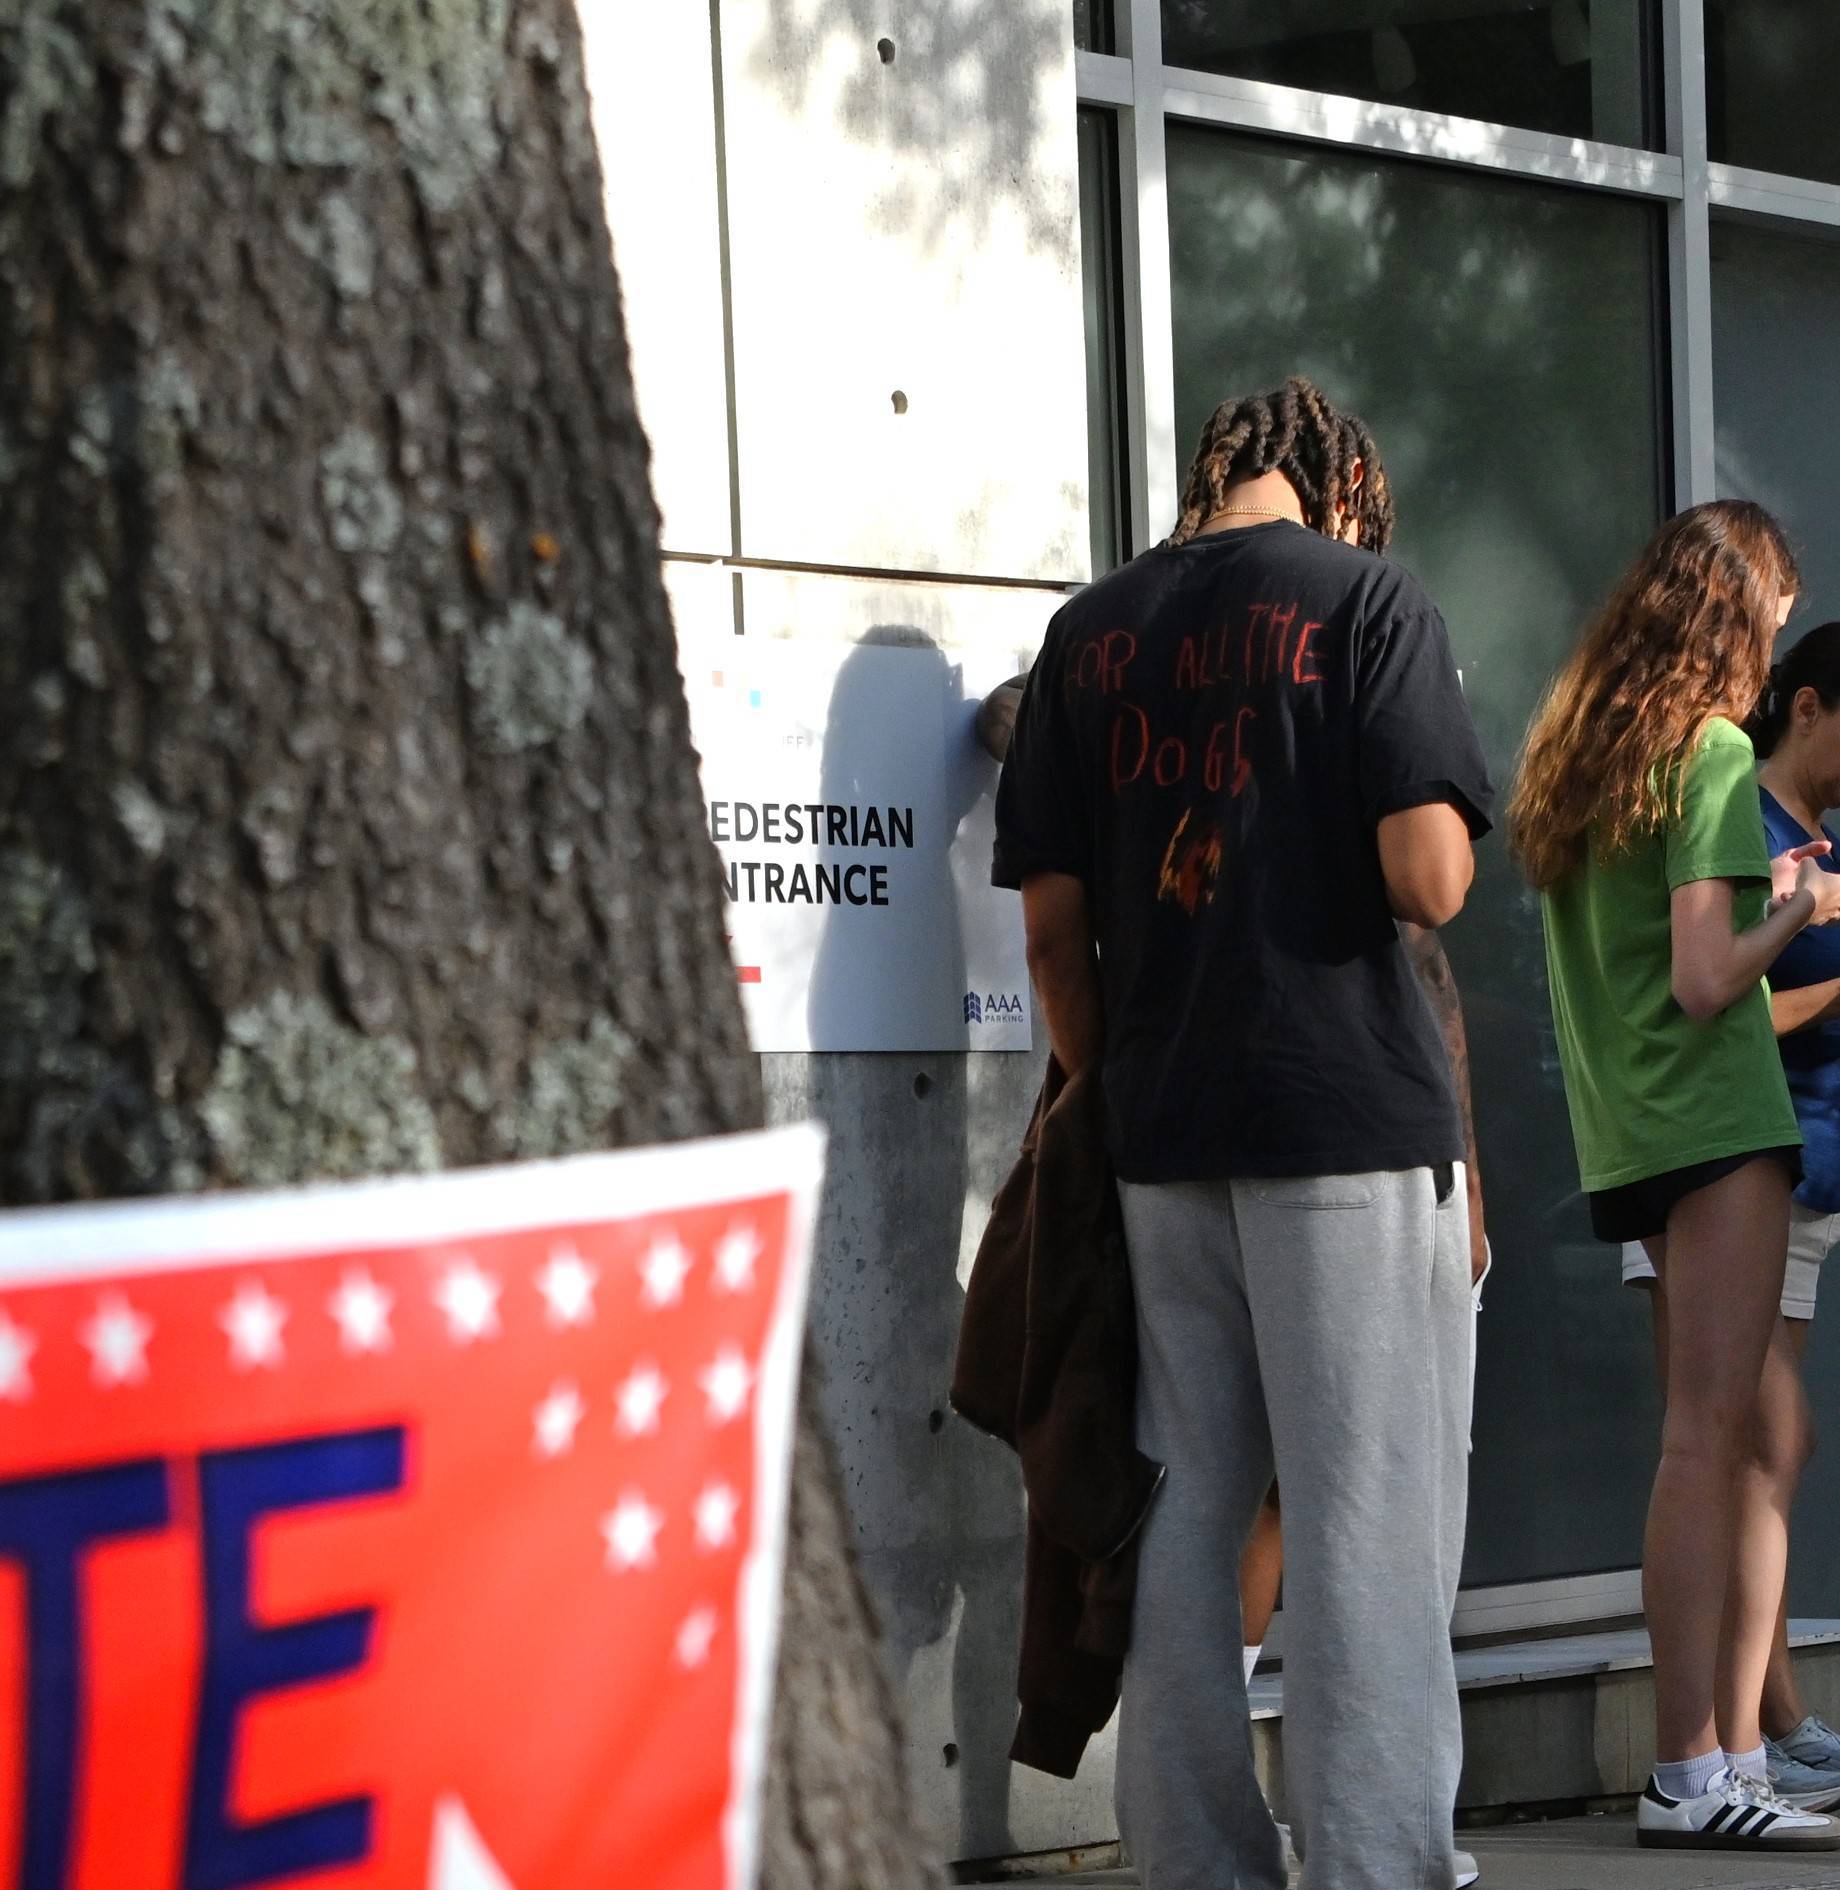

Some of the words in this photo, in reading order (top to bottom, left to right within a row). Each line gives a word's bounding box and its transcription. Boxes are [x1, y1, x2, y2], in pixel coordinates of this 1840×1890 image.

[1174, 624, 1233, 690] ALL
[1242, 601, 1330, 688] THE
[711, 801, 915, 849] EDESTRIAN
[724, 862, 889, 906] NTRANCE
[985, 994, 1023, 1013] AAA
[985, 1015, 1024, 1024] PARKING
